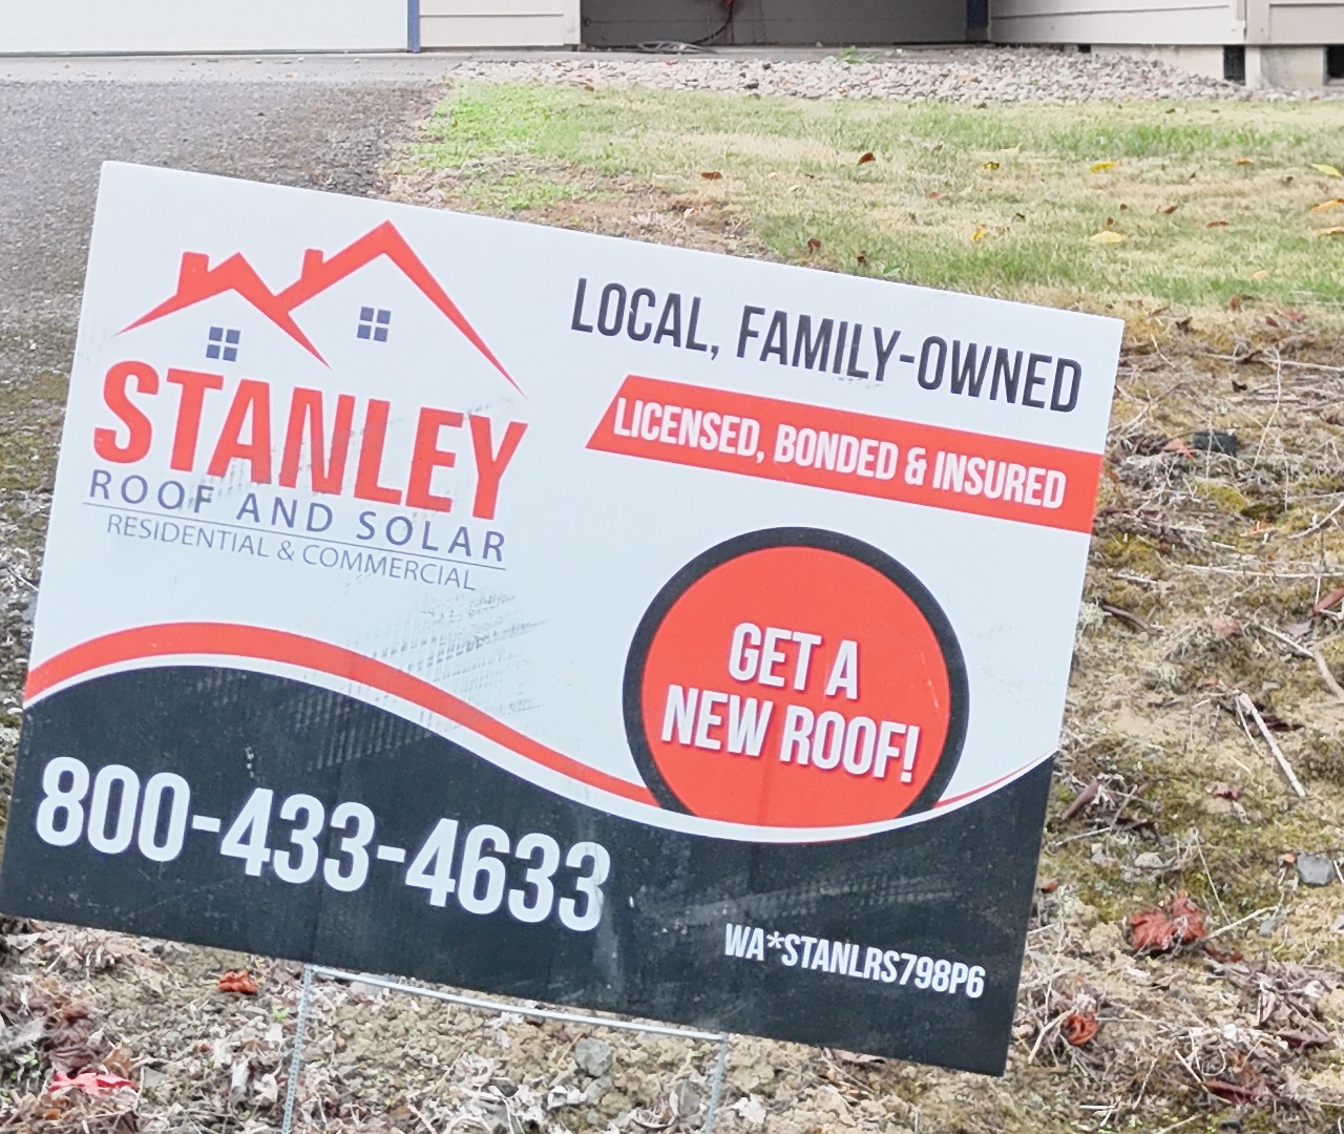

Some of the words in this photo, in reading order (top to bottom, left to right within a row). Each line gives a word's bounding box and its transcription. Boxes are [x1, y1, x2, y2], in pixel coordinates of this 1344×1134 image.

[571, 277, 720, 361] LOCAL,
[736, 305, 1083, 413] FAMILY-OWNED
[93, 360, 529, 521] STANLEY
[613, 397, 764, 465] LICENSED,
[774, 424, 899, 482] BONDED
[904, 447, 927, 486] &
[932, 451, 1067, 510] INSURED
[89, 469, 215, 514] ROOF
[236, 493, 333, 533] AND
[356, 511, 506, 563] SOLAR
[107, 513, 269, 558] RESIDENTIAL
[277, 543, 296, 562] &
[302, 544, 476, 592] COMMERCIAL
[728, 622, 822, 691] GET
[825, 640, 858, 700] A
[661, 684, 774, 757] NEW
[780, 704, 921, 783] ROOF!
[35, 756, 611, 932] 800-433-4633
